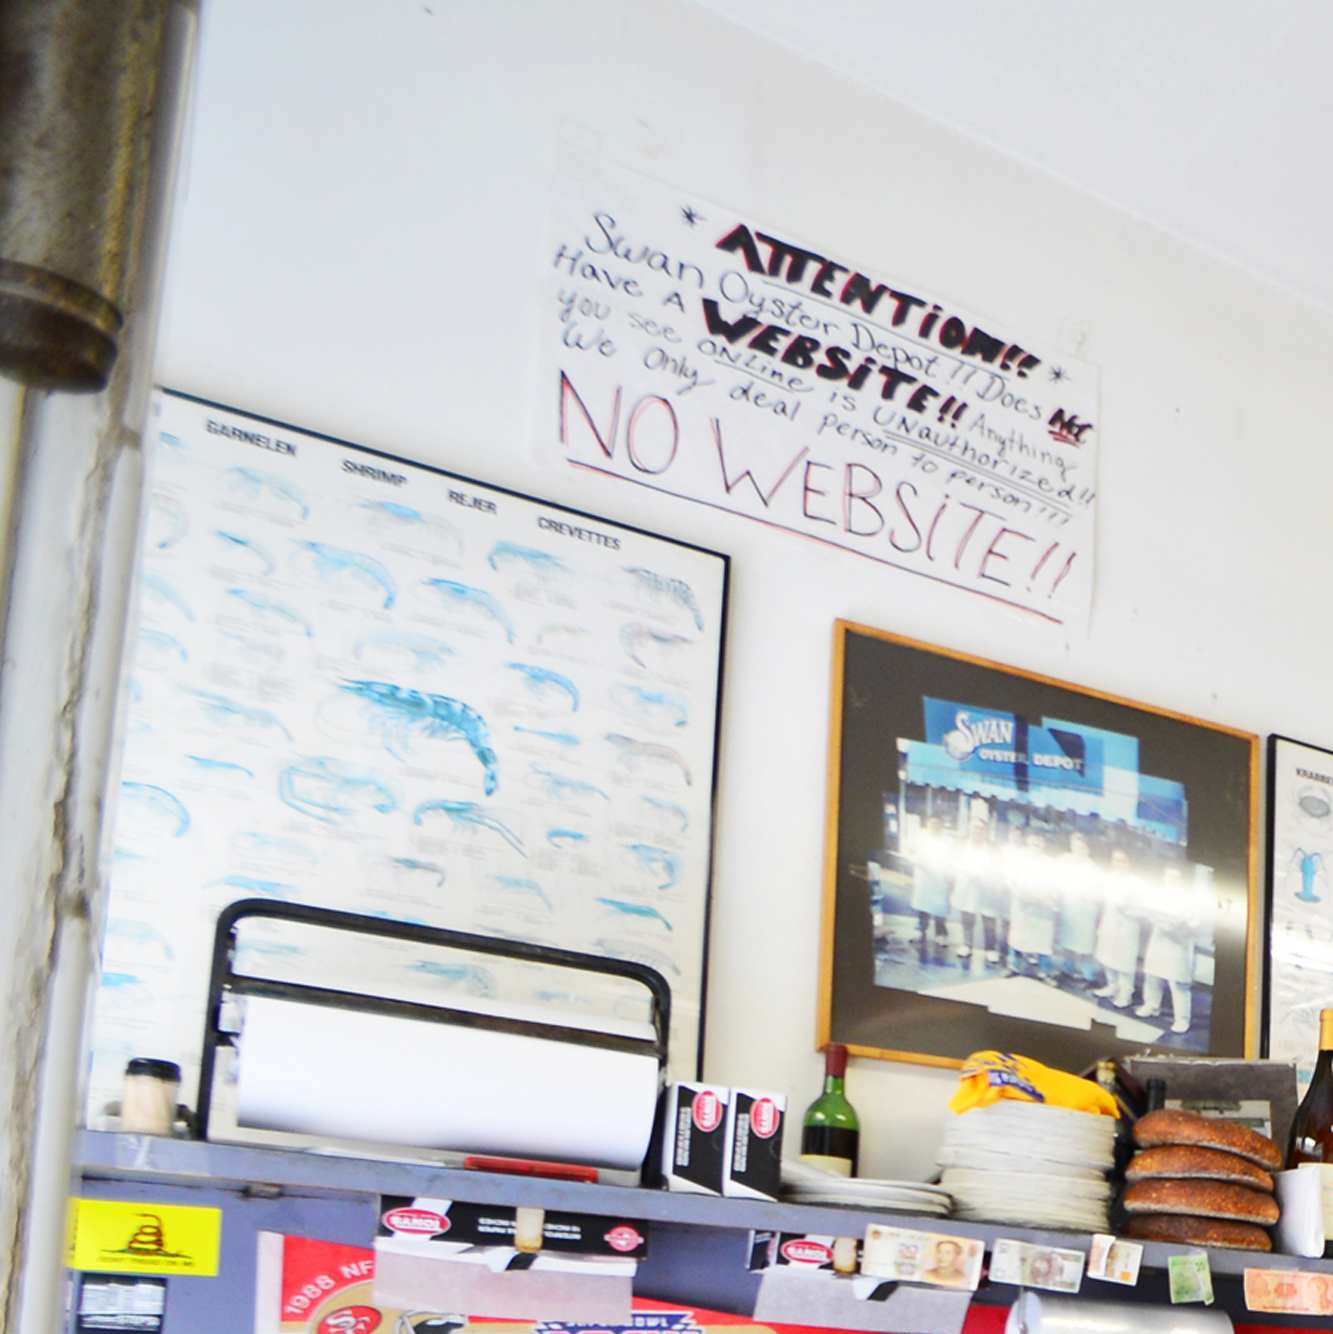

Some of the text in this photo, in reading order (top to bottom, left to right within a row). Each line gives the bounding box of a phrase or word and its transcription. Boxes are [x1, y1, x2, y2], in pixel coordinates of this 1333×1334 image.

[557, 289, 611, 324] you
[627, 311, 682, 344] see
[584, 211, 705, 290] Swan
[718, 270, 840, 337] Oyster
[554, 244, 643, 297] Have
[663, 291, 686, 313] A
[969, 412, 1077, 482] Anything
[561, 320, 617, 358] We
[728, 382, 802, 422] deal
[817, 413, 898, 457] person
[910, 454, 940, 475] to
[559, 368, 680, 475] NO
[340, 458, 408, 487] SHRIMP
[536, 516, 622, 551] CREVETTES
[284, 1259, 375, 1315] 1988 NF
